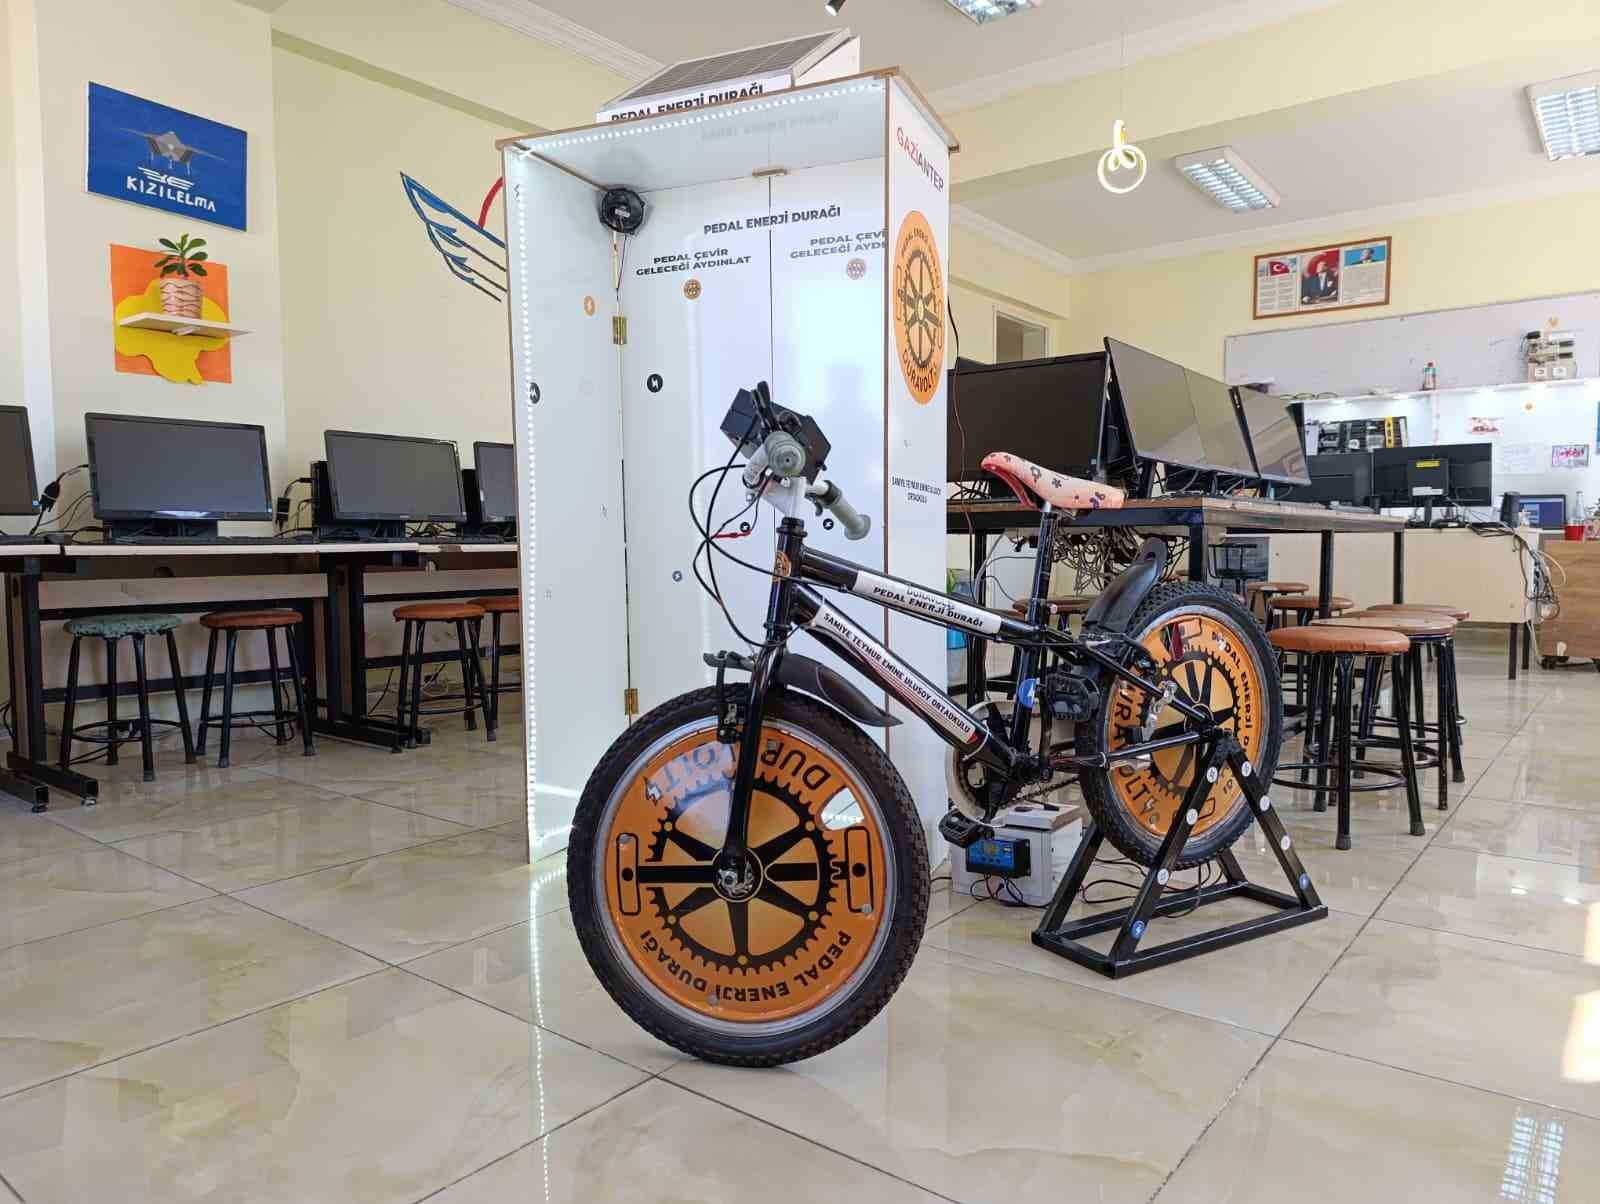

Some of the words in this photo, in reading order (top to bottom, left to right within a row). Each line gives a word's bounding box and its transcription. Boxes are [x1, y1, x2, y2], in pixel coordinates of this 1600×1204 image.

[704, 219, 743, 234] PEDAL
[746, 210, 788, 229] ENERJİ
[791, 204, 841, 223] DURAĞI
[810, 234, 852, 246] PEDAL
[636, 262, 690, 276] GELECEĞİ
[692, 255, 752, 270] AYDINLAT
[653, 254, 690, 264] PEDAL
[694, 247, 729, 261] ÇEVİR
[873, 586, 906, 603] PEDAL
[908, 597, 945, 615] ENERJİ
[947, 609, 984, 627] DURAĞI
[851, 634, 883, 663] TEYMUR
[640, 929, 708, 992] DURAĞI
[793, 931, 851, 986] PEDAL
[715, 980, 790, 1002] ENERJİ
